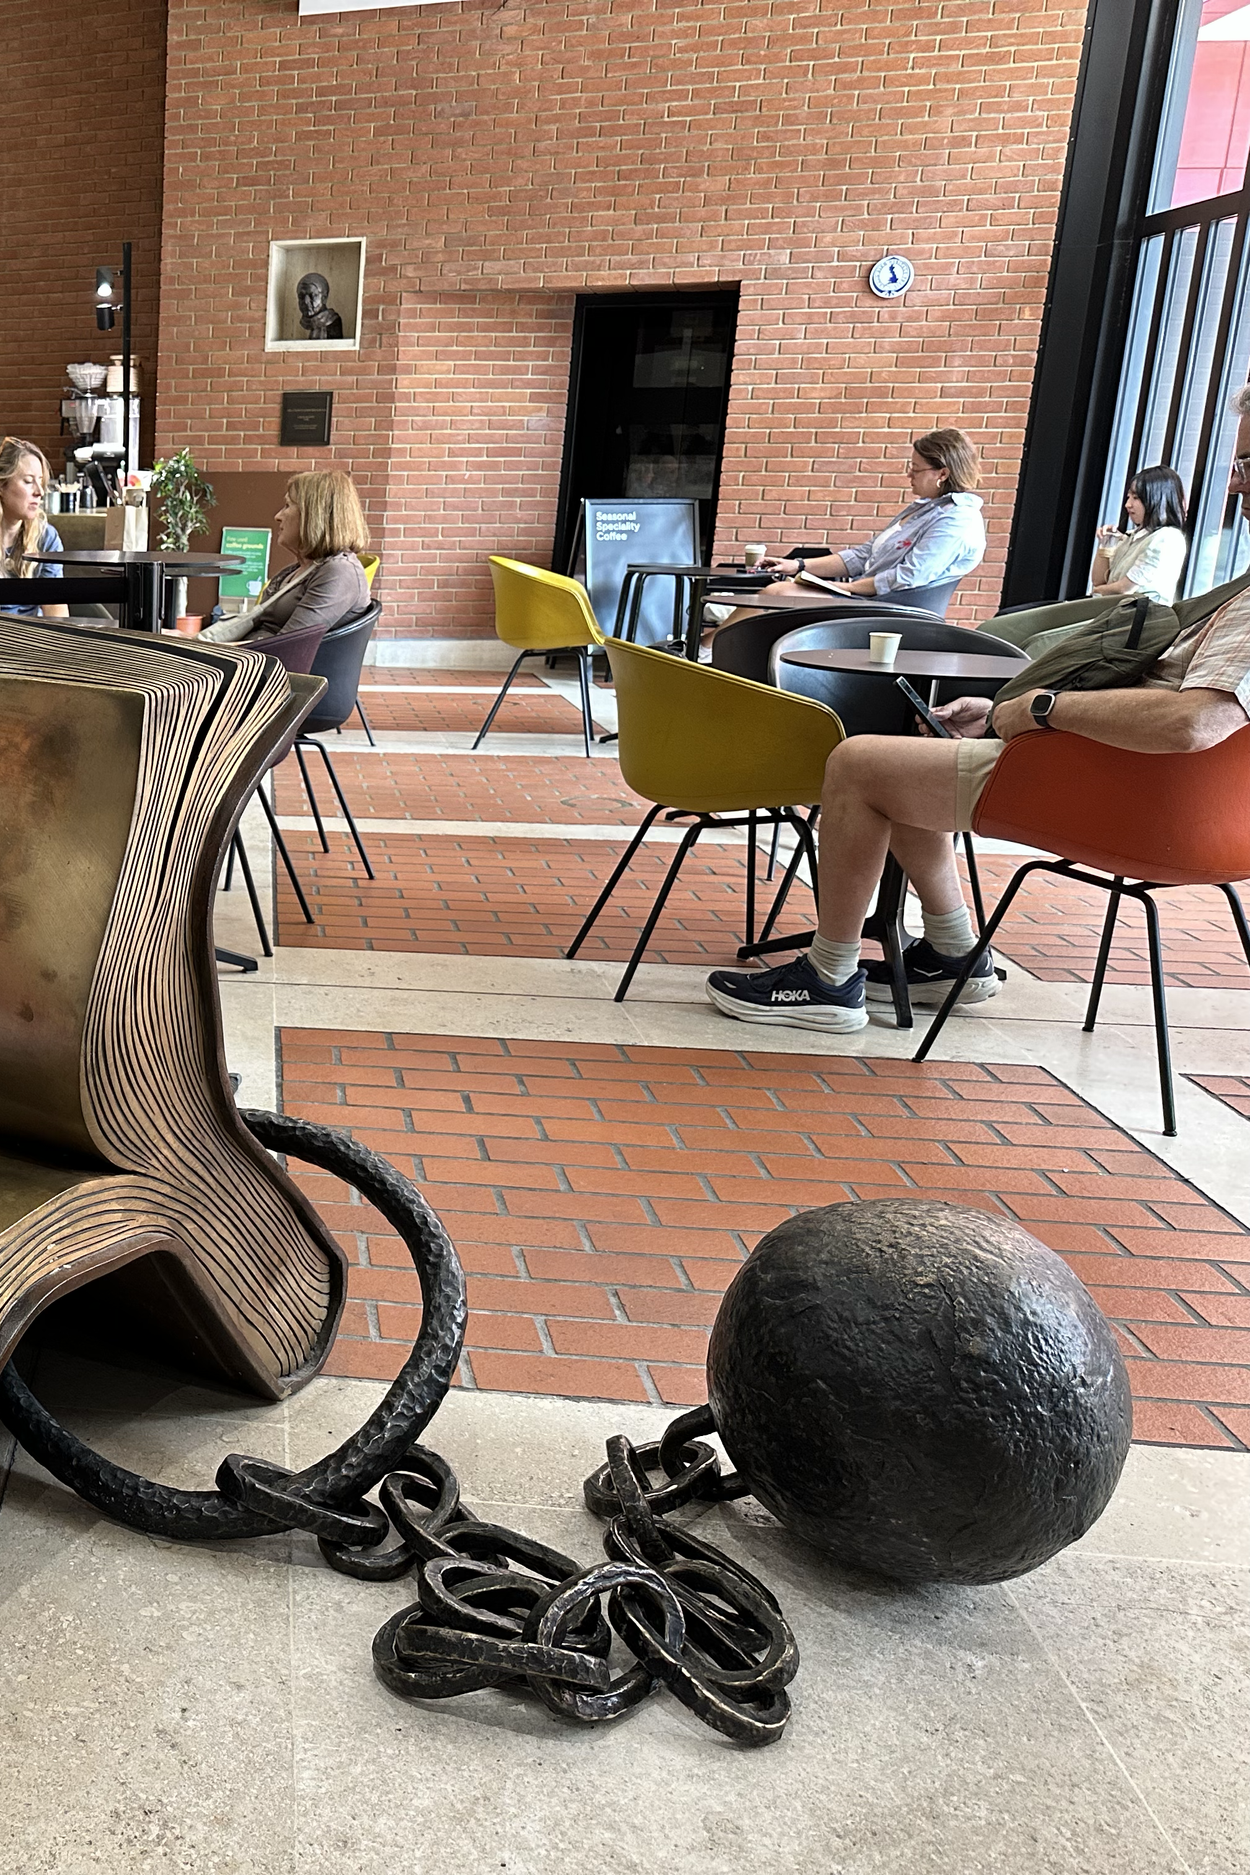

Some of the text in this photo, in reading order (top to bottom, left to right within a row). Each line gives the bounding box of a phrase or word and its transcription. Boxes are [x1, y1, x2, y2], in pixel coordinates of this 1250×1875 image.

[596, 511, 636, 521] Seasonal
[596, 522, 640, 532] Speciality
[596, 532, 627, 541] Coffee
[771, 990, 810, 1001] HOKA
